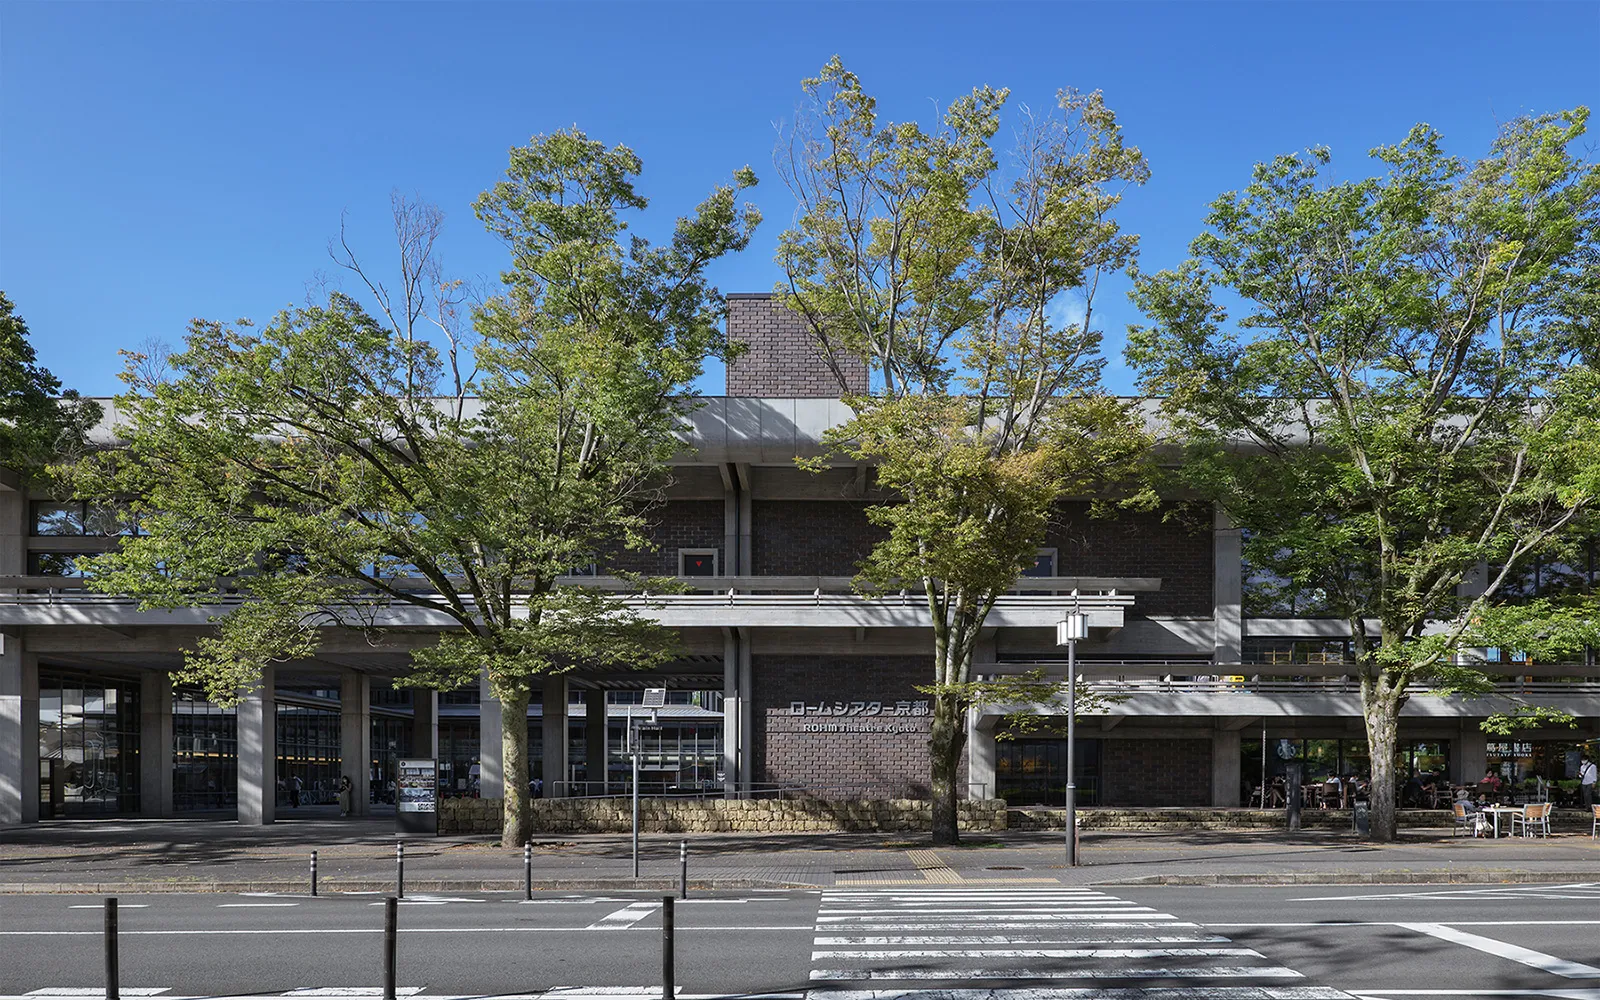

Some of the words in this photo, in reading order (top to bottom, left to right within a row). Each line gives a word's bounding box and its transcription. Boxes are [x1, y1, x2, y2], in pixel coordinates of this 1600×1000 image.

[790, 700, 929, 716] ロームシアター京都
[803, 723, 837, 732] ROHM
[839, 723, 882, 732] Theatre
[885, 723, 916, 735] Kyoto
